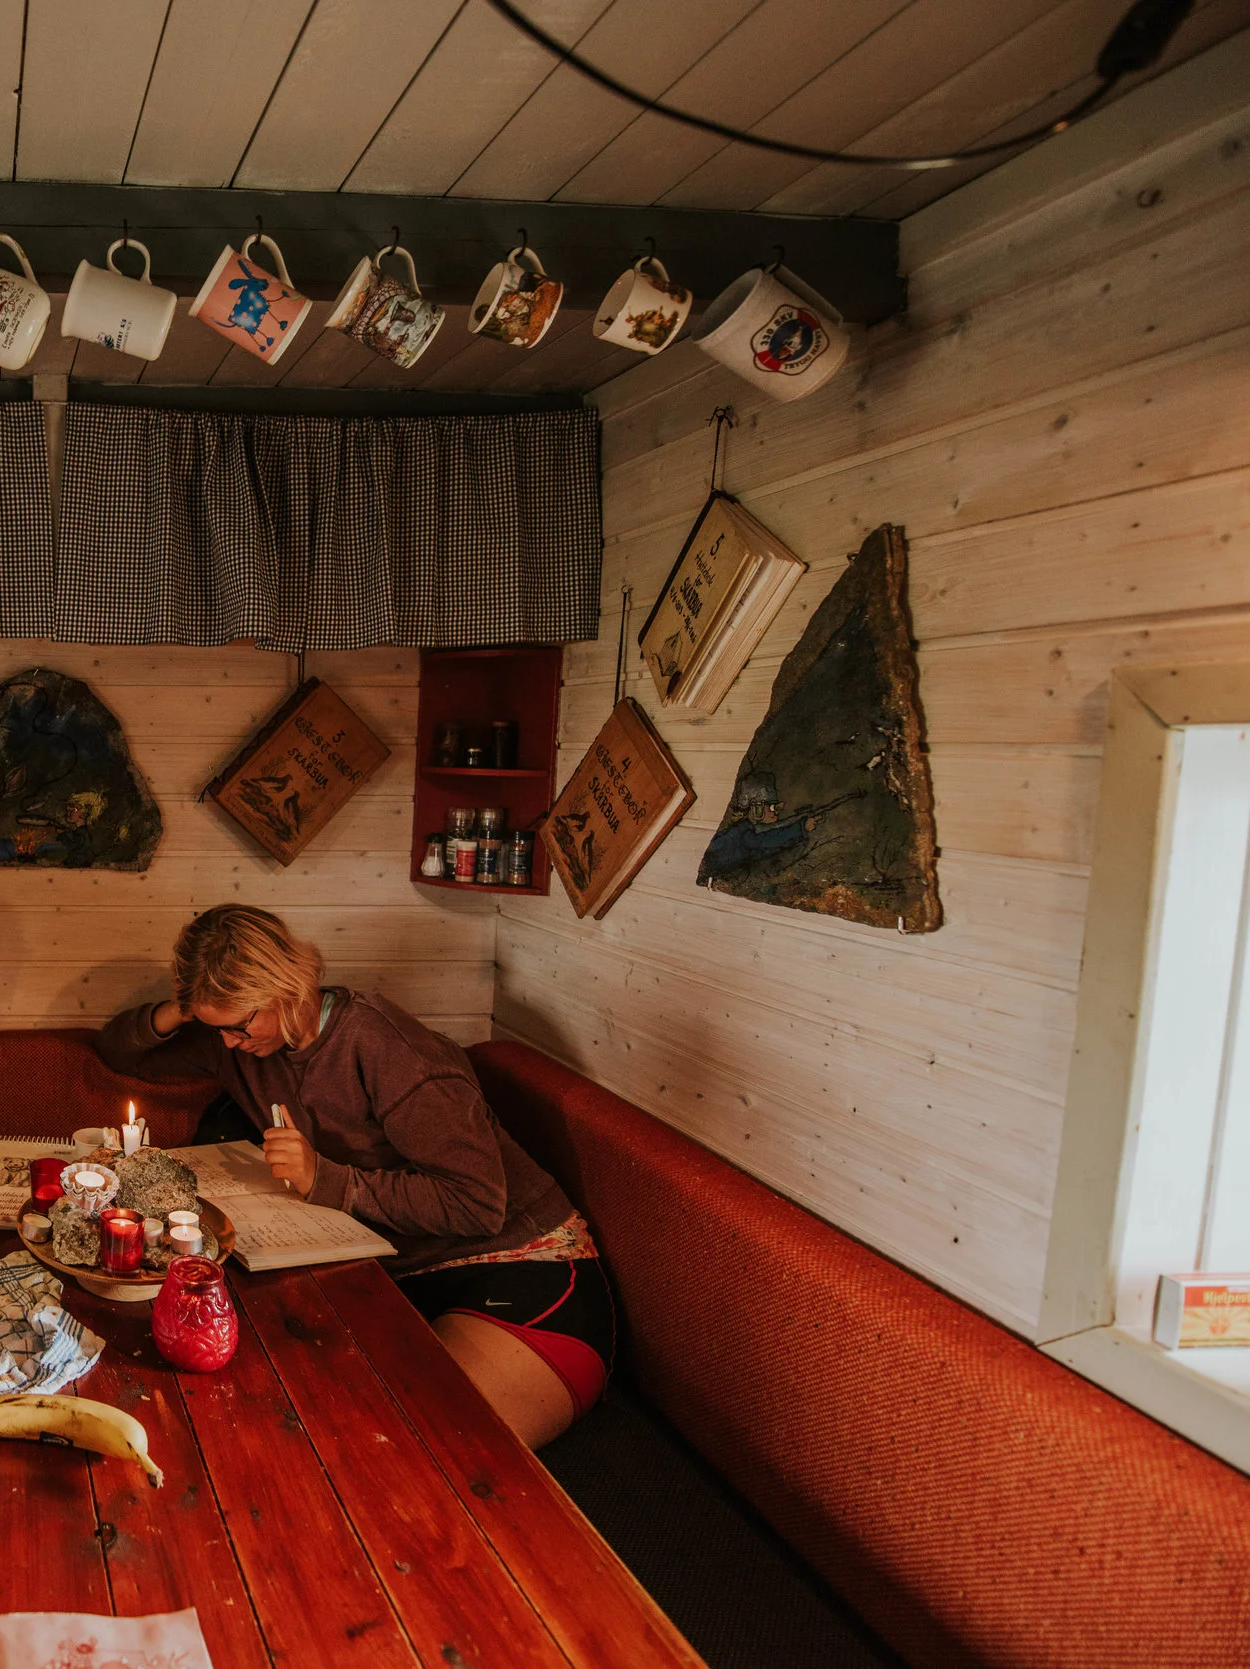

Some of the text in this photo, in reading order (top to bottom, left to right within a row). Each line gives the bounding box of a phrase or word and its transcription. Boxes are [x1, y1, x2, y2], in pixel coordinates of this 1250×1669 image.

[760, 311, 794, 347] 330 SKV
[287, 748, 329, 790] SKARBUA
[587, 776, 621, 835] SKARBUA
